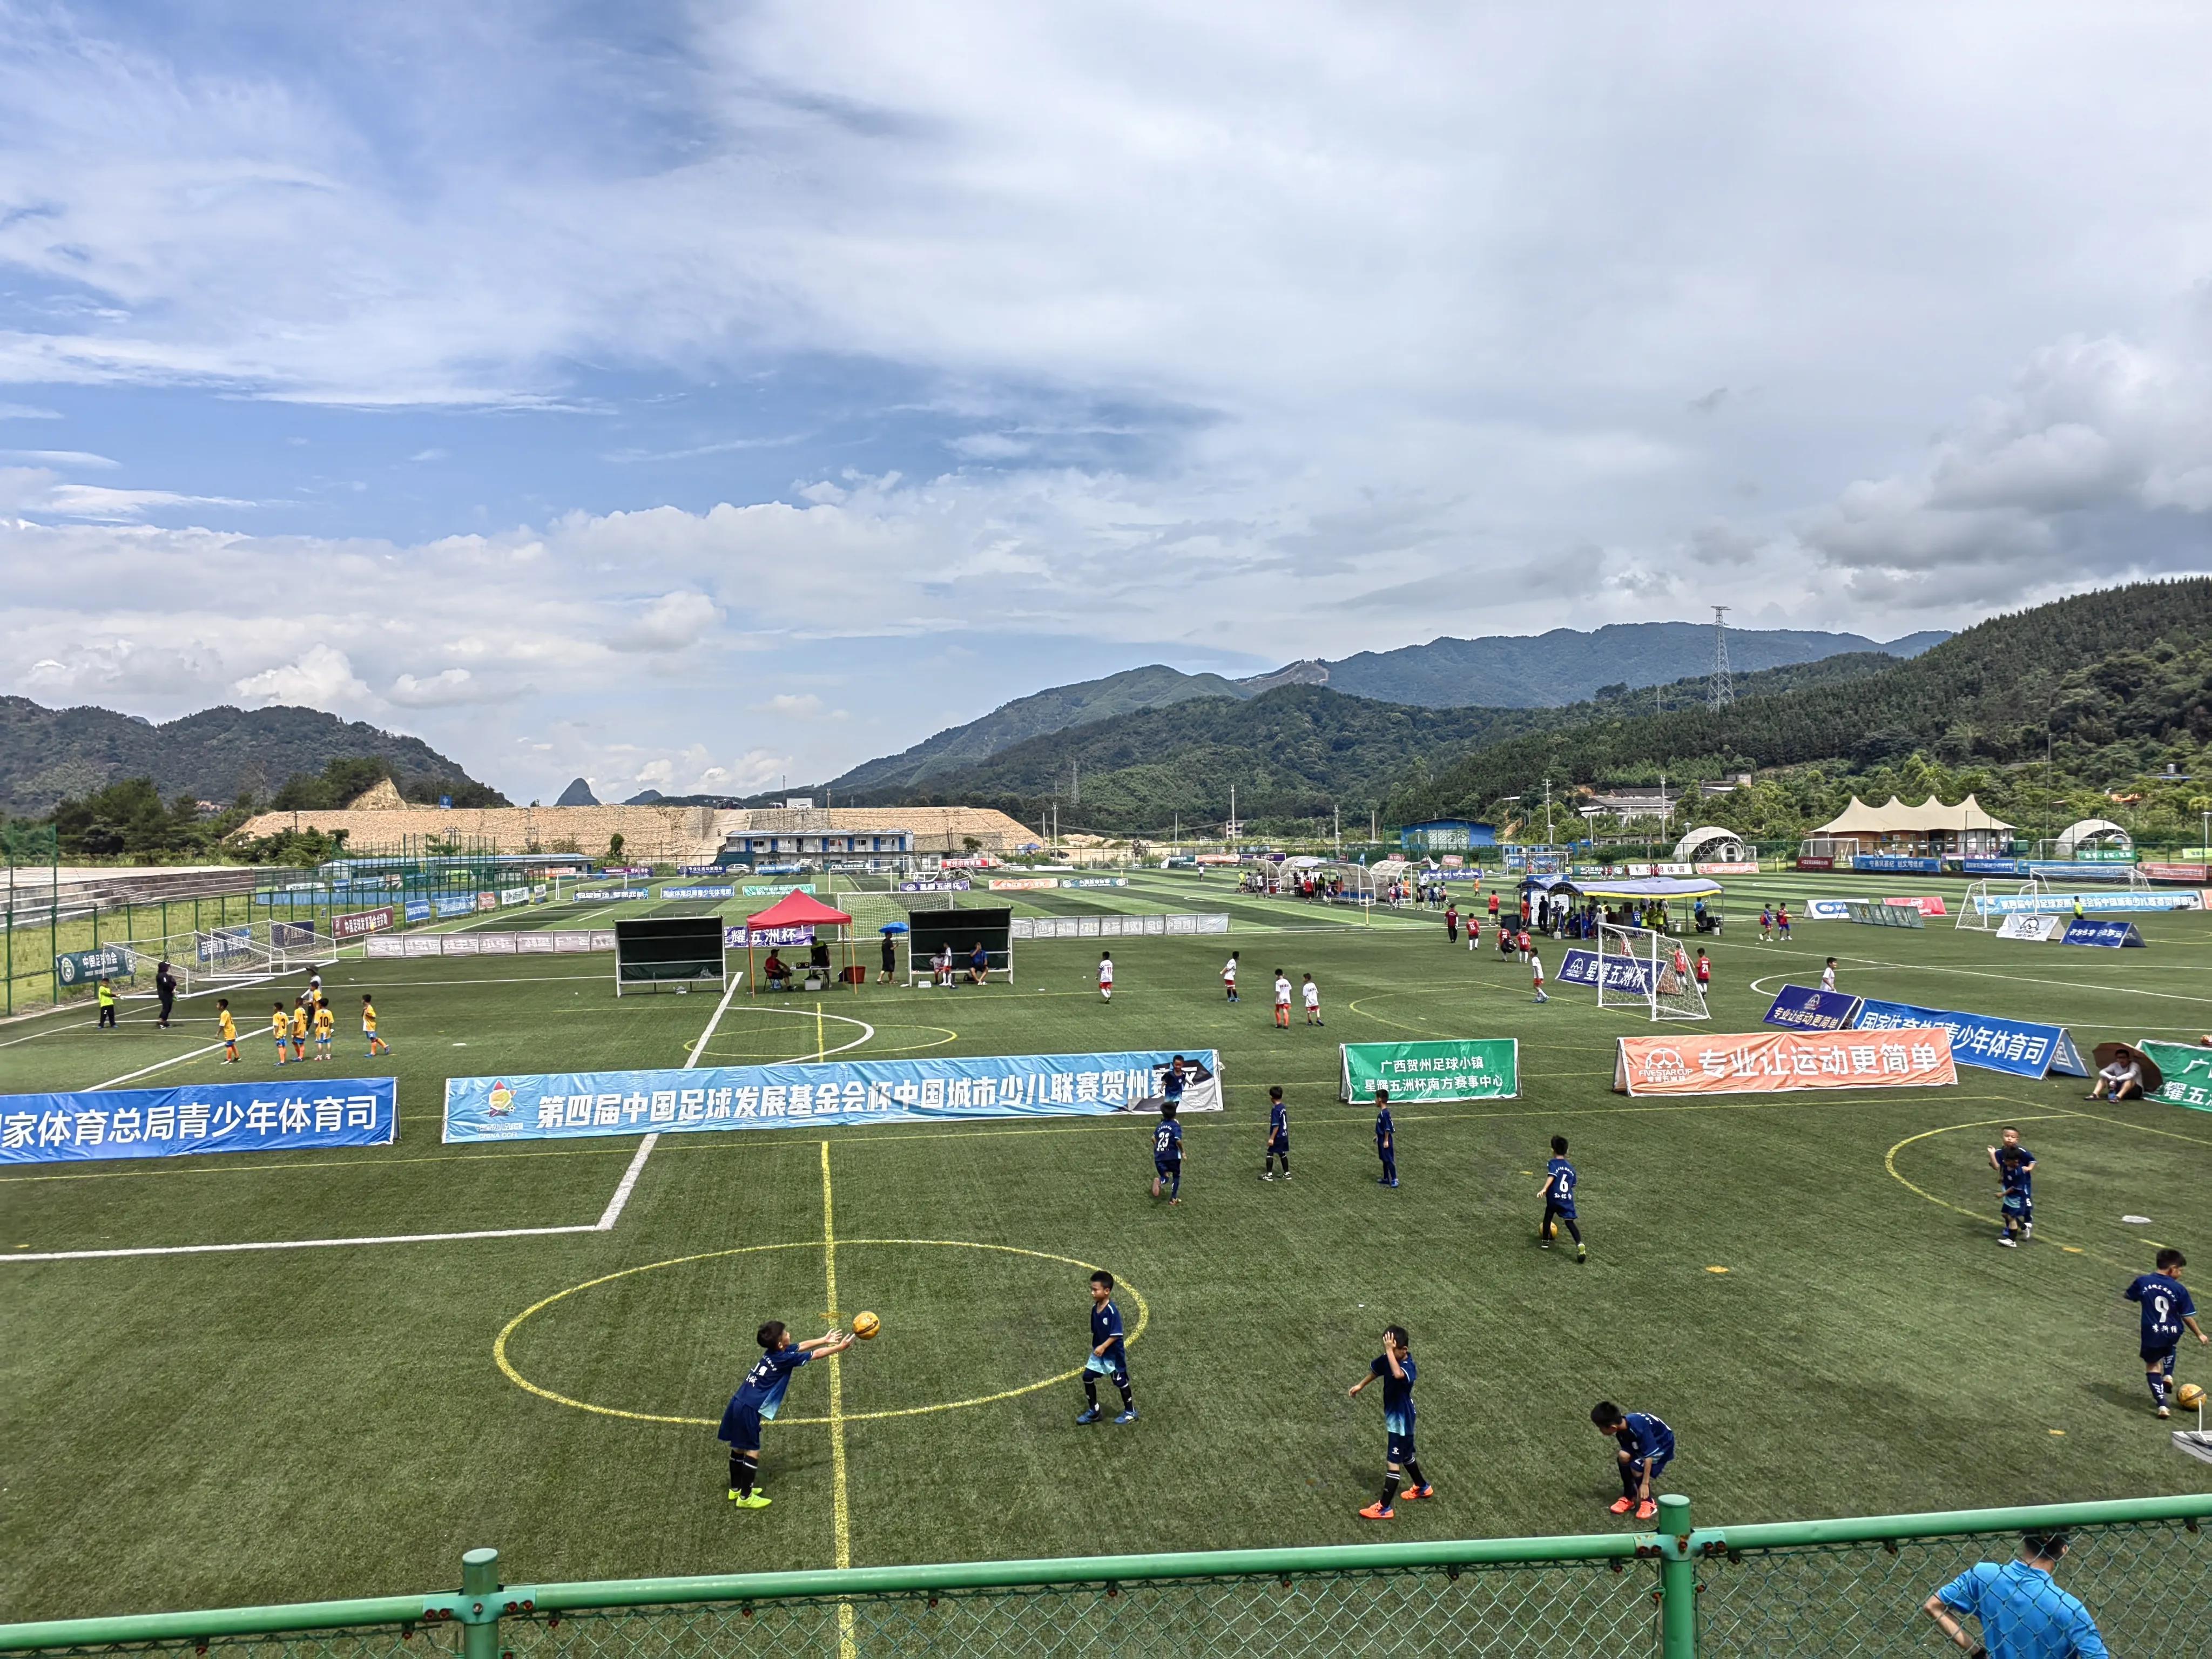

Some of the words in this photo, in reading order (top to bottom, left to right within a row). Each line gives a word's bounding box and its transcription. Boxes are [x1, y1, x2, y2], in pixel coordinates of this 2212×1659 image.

[281, 1017, 286, 1029] 3
[320, 1016, 329, 1028] 10
[1773, 1007, 1839, 1030] 专业让运动更简单
[1380, 1056, 1483, 1074] 广西贺州足球小镇
[1698, 1042, 1940, 1078] 专业让运动更简单
[1365, 1074, 1503, 1092] 星耀五洲杯南方赛事中心
[0, 1095, 377, 1148] 家体育总局青少年体育司
[1158, 1131, 1170, 1148] 23
[1559, 1174, 1569, 1193] 6
[2154, 1296, 2169, 1323] 9
